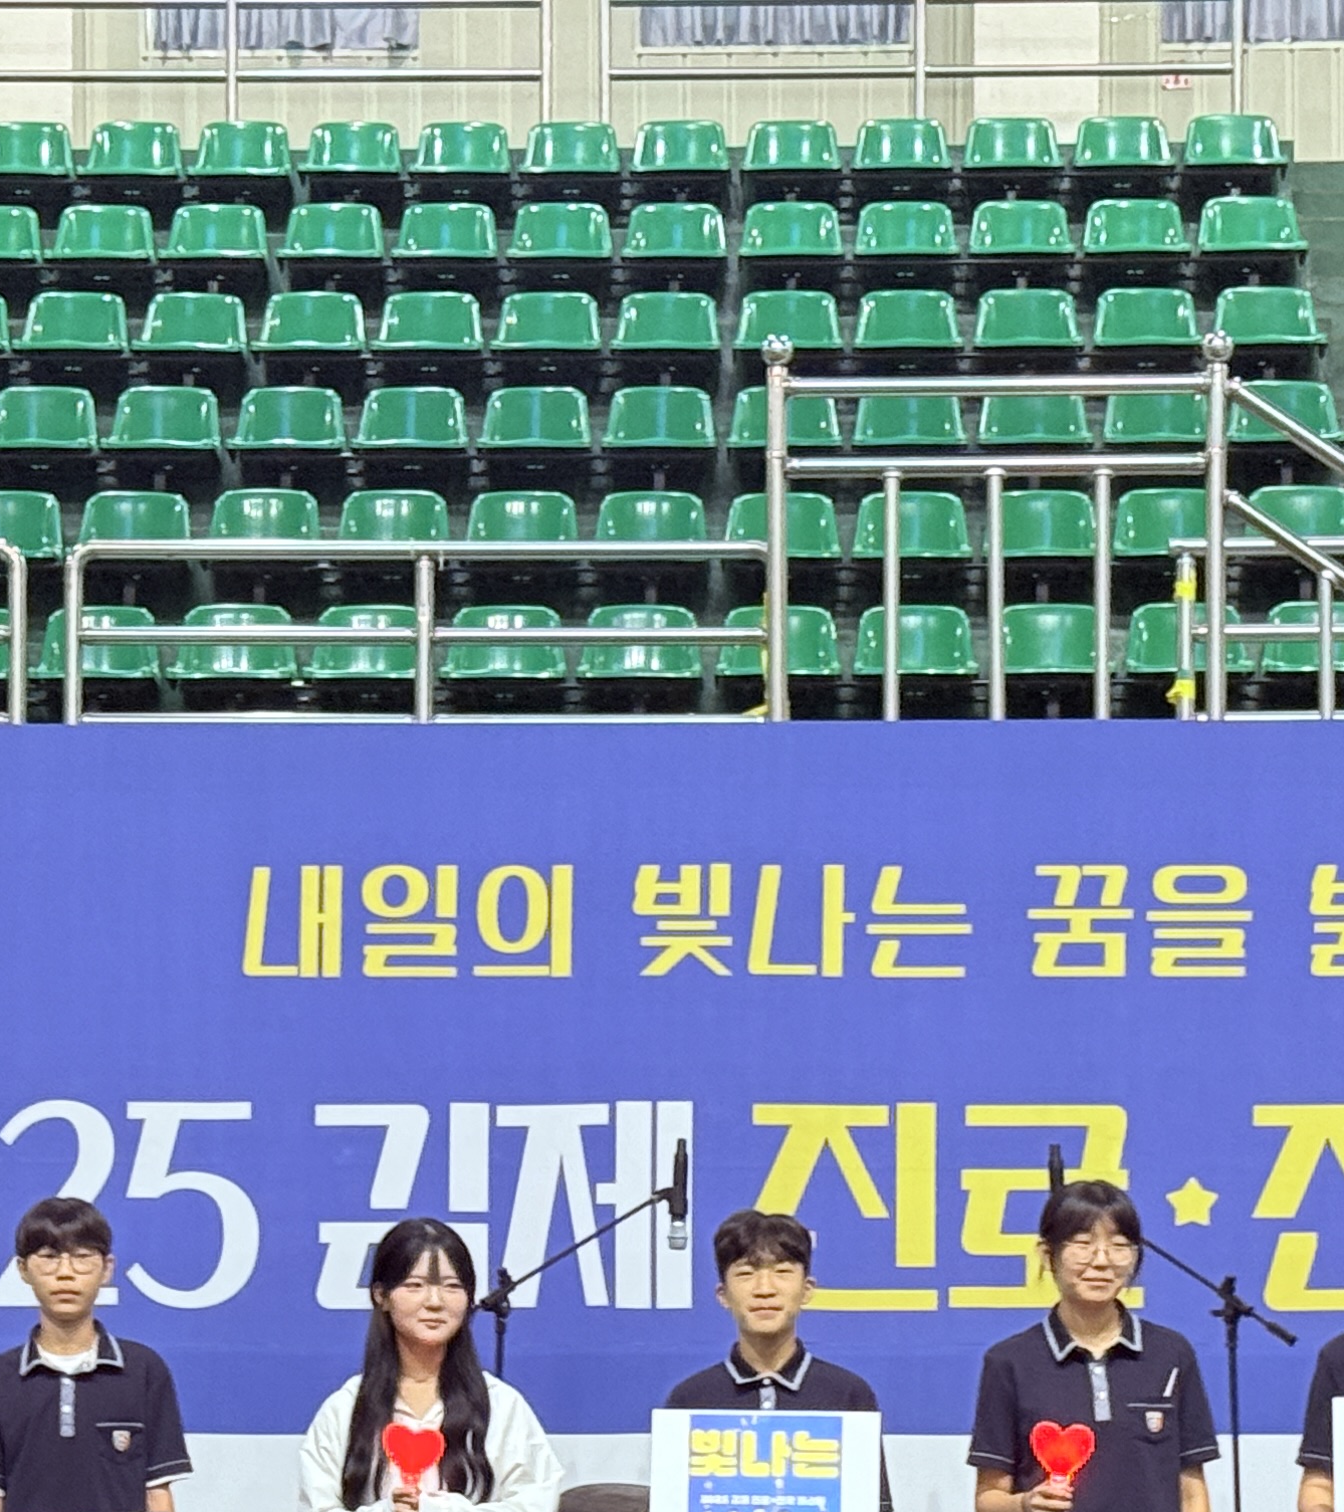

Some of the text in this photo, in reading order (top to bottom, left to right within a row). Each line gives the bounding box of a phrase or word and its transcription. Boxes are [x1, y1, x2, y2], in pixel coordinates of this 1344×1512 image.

[242, 864, 574, 979] 내일의
[631, 863, 972, 978] 빛나는
[1026, 864, 1256, 978] 꿈을
[314, 1100, 693, 1312] 김제
[751, 1101, 1131, 1312] 진로
[689, 1428, 841, 1479] 빛나는
